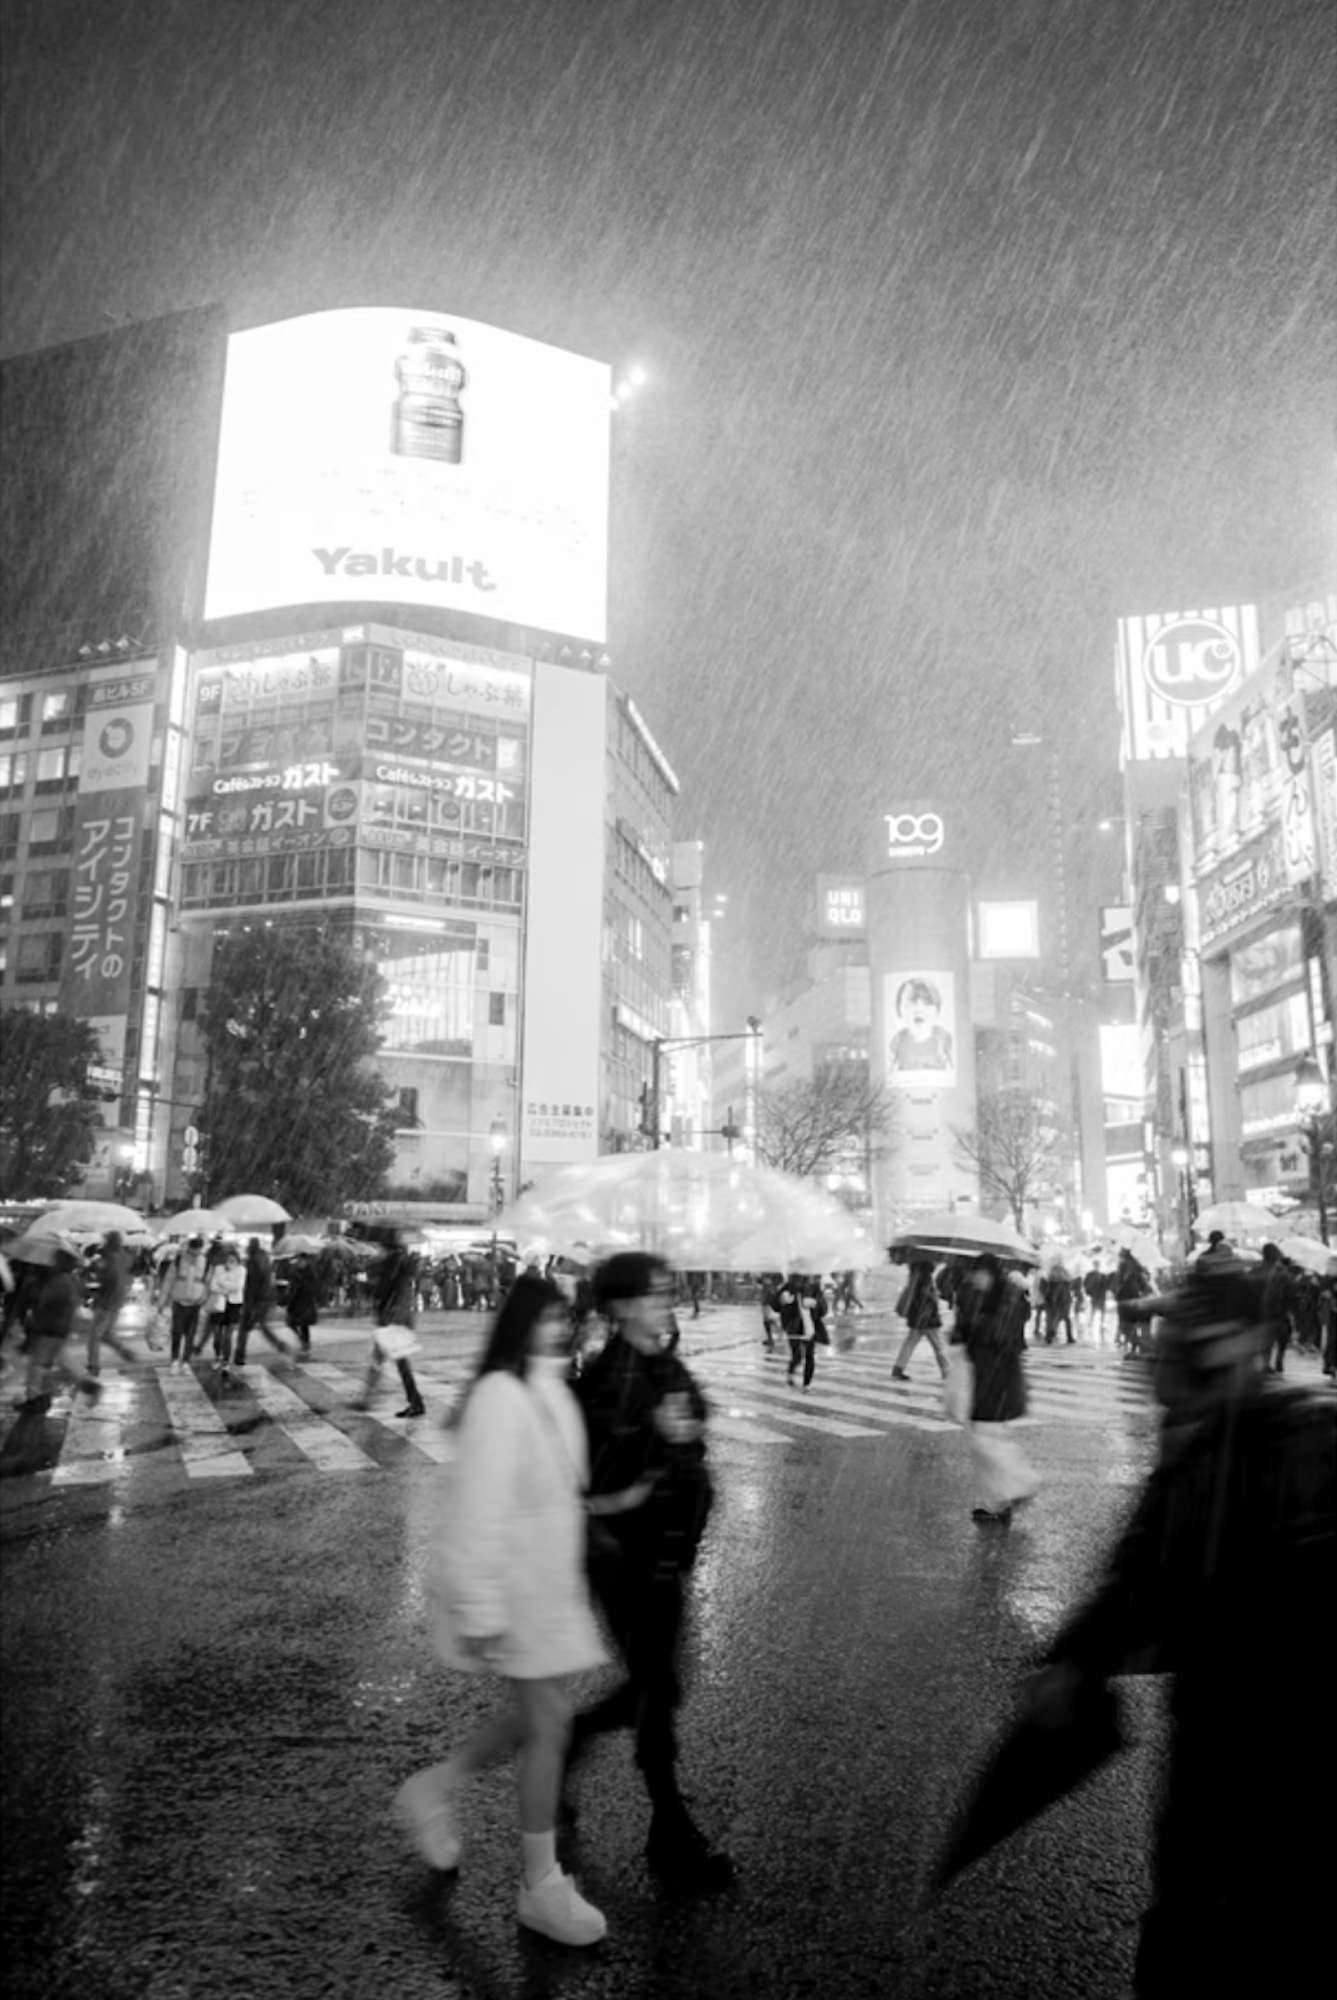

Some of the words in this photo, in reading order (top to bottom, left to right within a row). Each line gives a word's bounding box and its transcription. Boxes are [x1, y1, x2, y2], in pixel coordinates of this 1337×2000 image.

[312, 546, 497, 592] Yakult
[367, 717, 493, 760] コンタクト
[281, 760, 341, 791] ガスト
[453, 775, 515, 803] ガスト
[188, 812, 213, 832] 7F
[250, 798, 319, 832] ガスト
[884, 812, 944, 854] 109
[71, 818, 111, 980] アイシティ
[101, 816, 135, 978] コンタクトの
[826, 889, 860, 906] UNI
